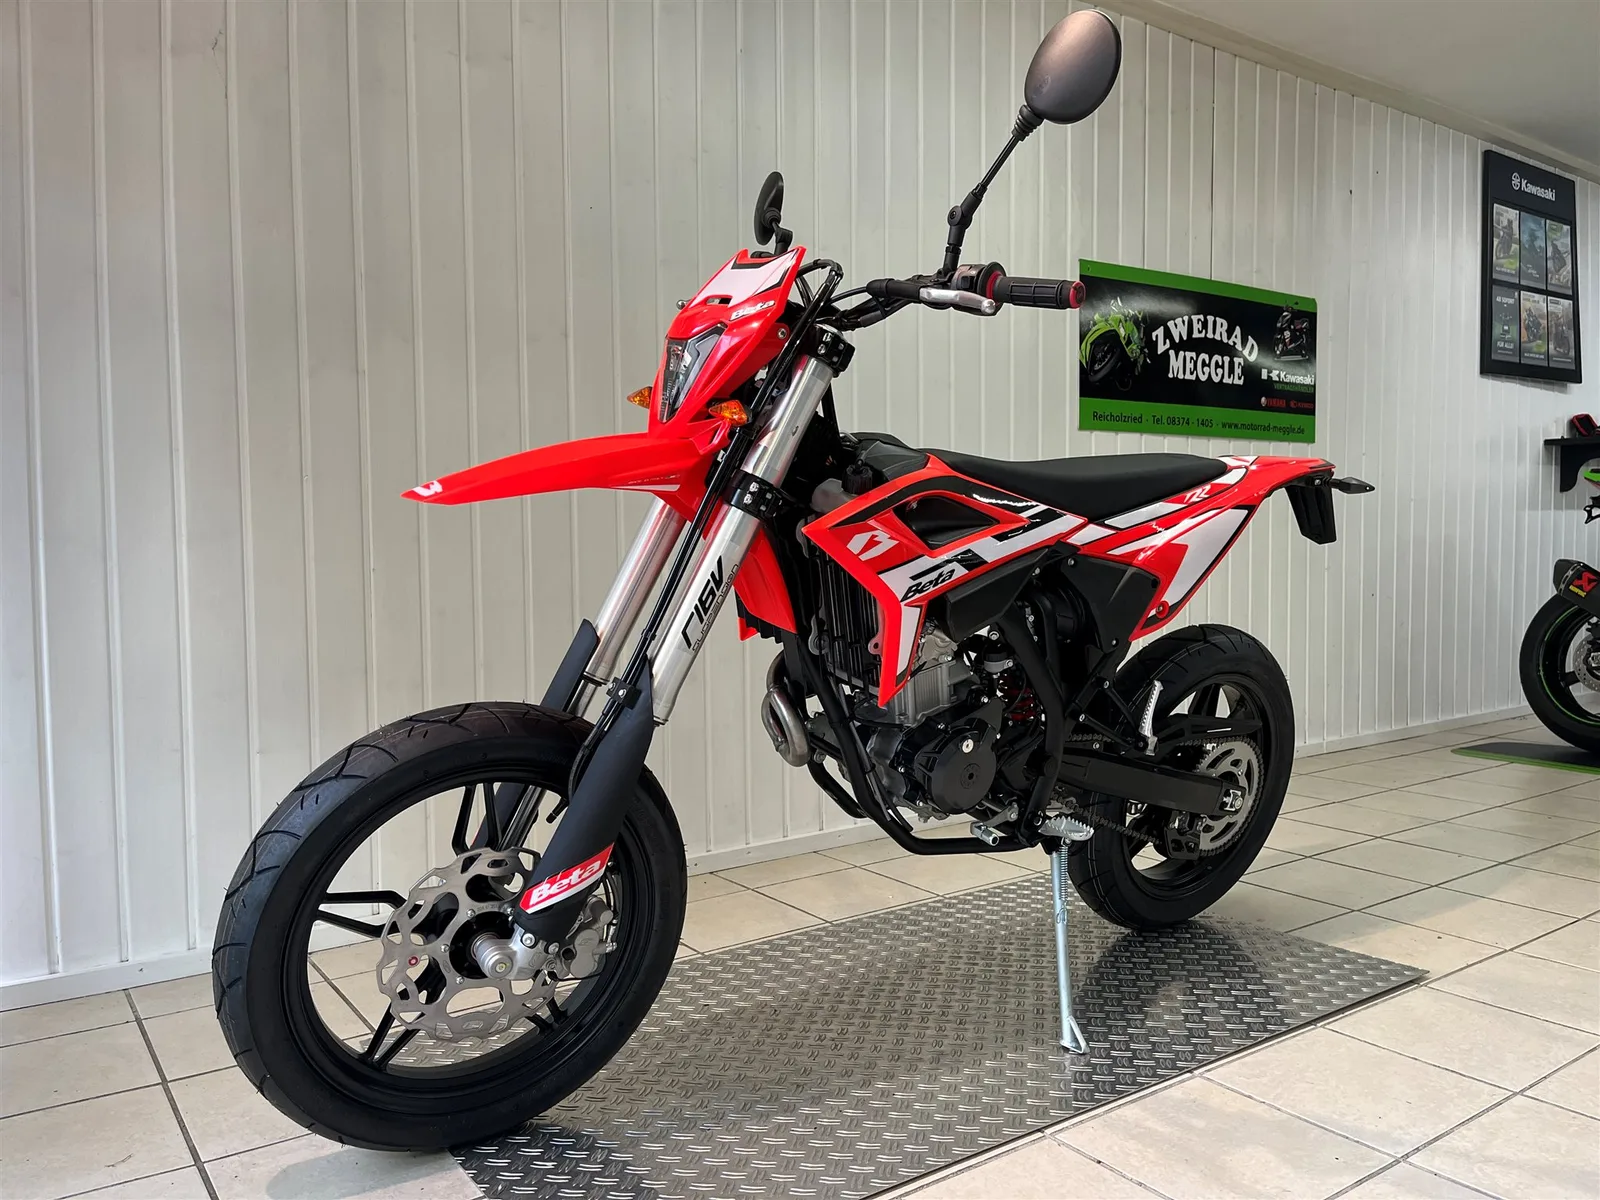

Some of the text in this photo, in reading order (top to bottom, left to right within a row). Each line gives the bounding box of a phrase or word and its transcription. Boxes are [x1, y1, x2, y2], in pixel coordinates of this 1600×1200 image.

[1521, 178, 1555, 201] Kawasaki
[730, 300, 775, 321] Beta
[1152, 314, 1258, 362] ZWEIRAD
[1168, 350, 1244, 385] MEGGLE
[1280, 370, 1315, 385] Kawasaki
[1092, 410, 1305, 435] Reicholzried Tel. 08374 1405 www.motorrad-meggle.de
[900, 568, 955, 602] Beta
[529, 861, 601, 906] Beta
